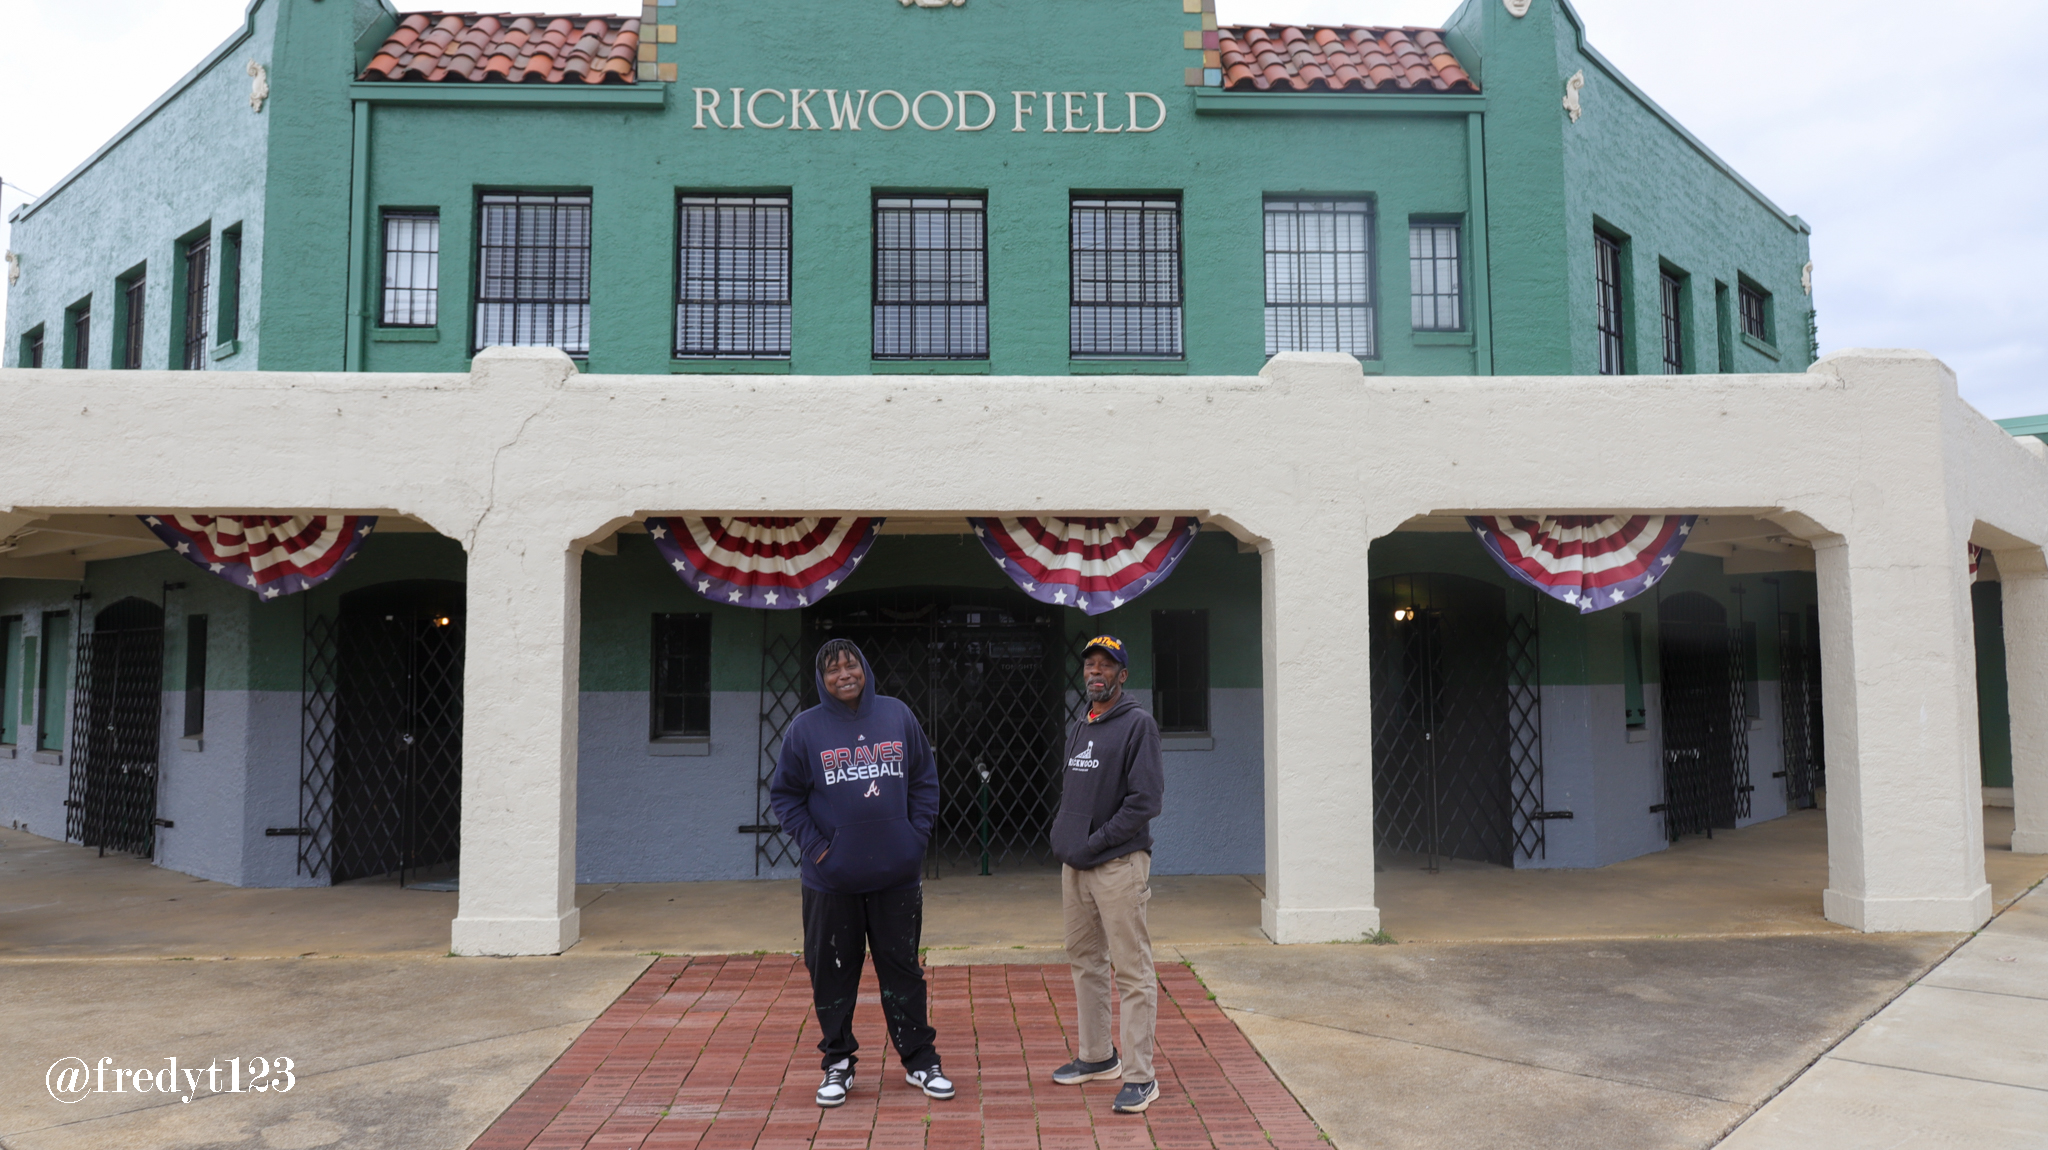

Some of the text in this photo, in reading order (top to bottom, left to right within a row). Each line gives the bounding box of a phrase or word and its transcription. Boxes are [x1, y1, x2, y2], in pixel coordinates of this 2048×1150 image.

[692, 87, 1167, 133] RICKWOOD FIELD
[820, 741, 903, 772] BRAVES
[825, 762, 902, 785] BASEBALL
